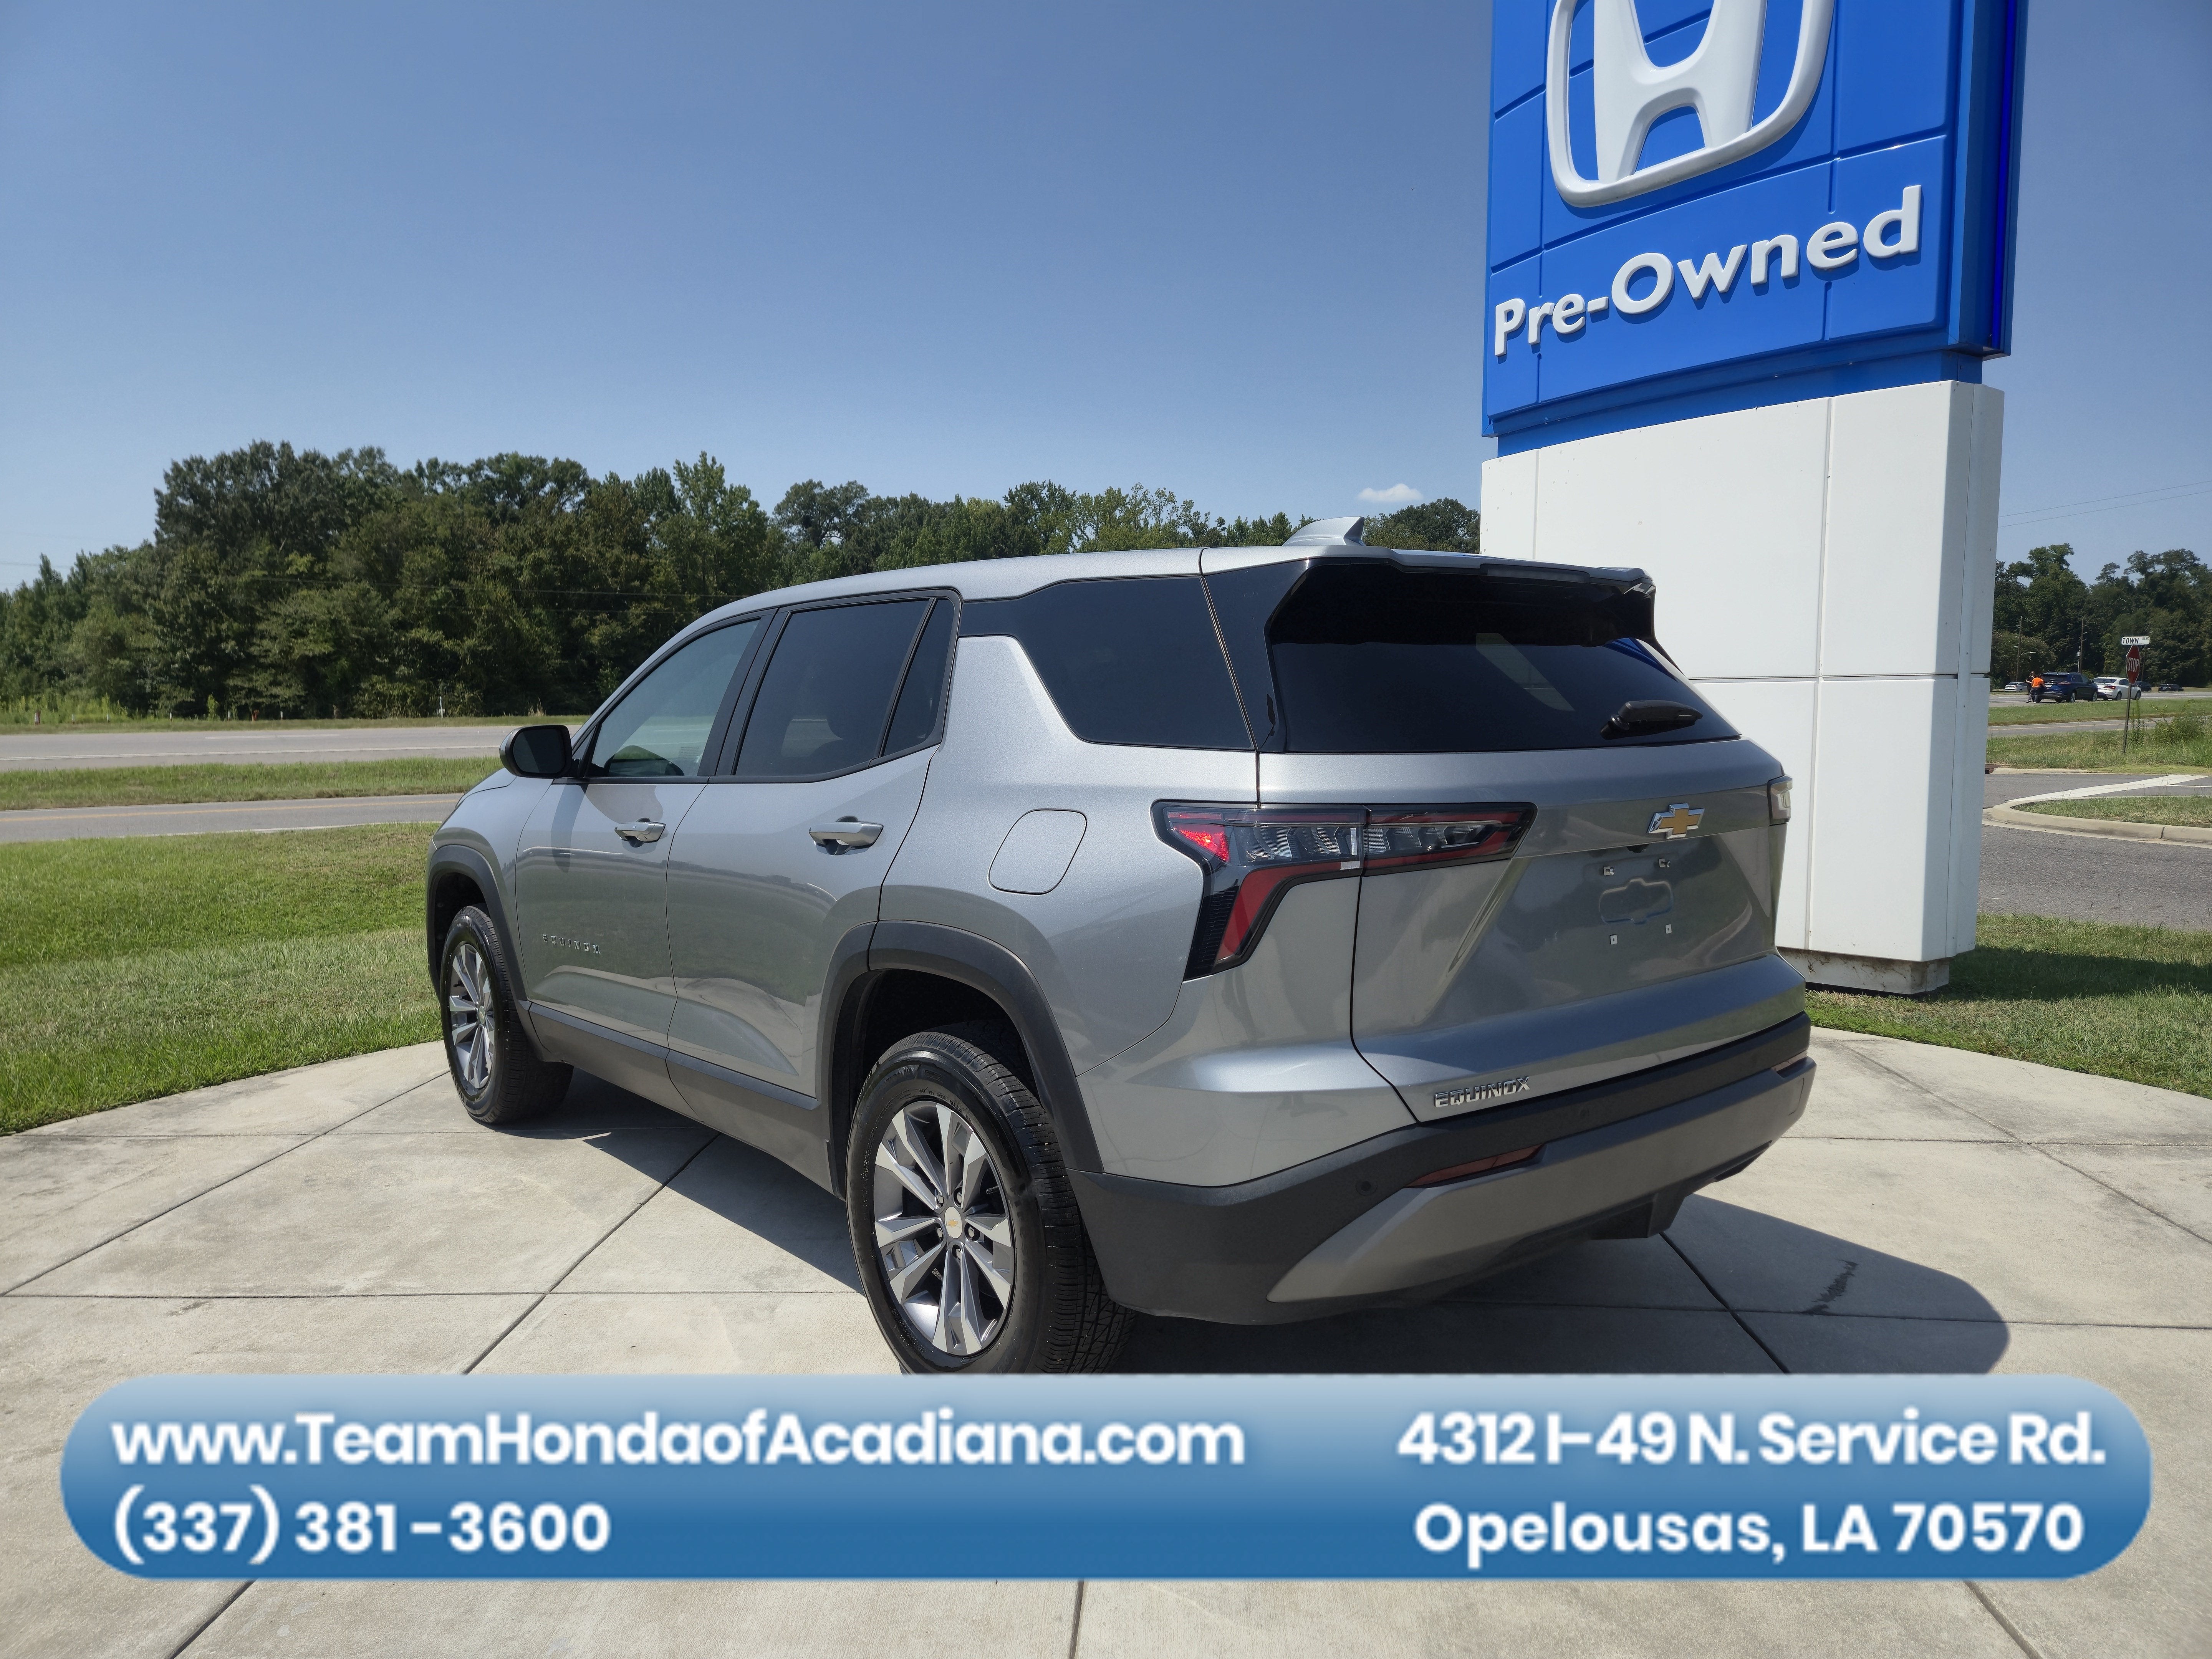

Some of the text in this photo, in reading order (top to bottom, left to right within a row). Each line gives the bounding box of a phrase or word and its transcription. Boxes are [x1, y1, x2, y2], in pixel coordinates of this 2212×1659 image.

[1494, 184, 1922, 356] Pre-Owned
[2128, 657, 2139, 672] STOP
[1434, 1076, 1530, 1108] EQUINOX
